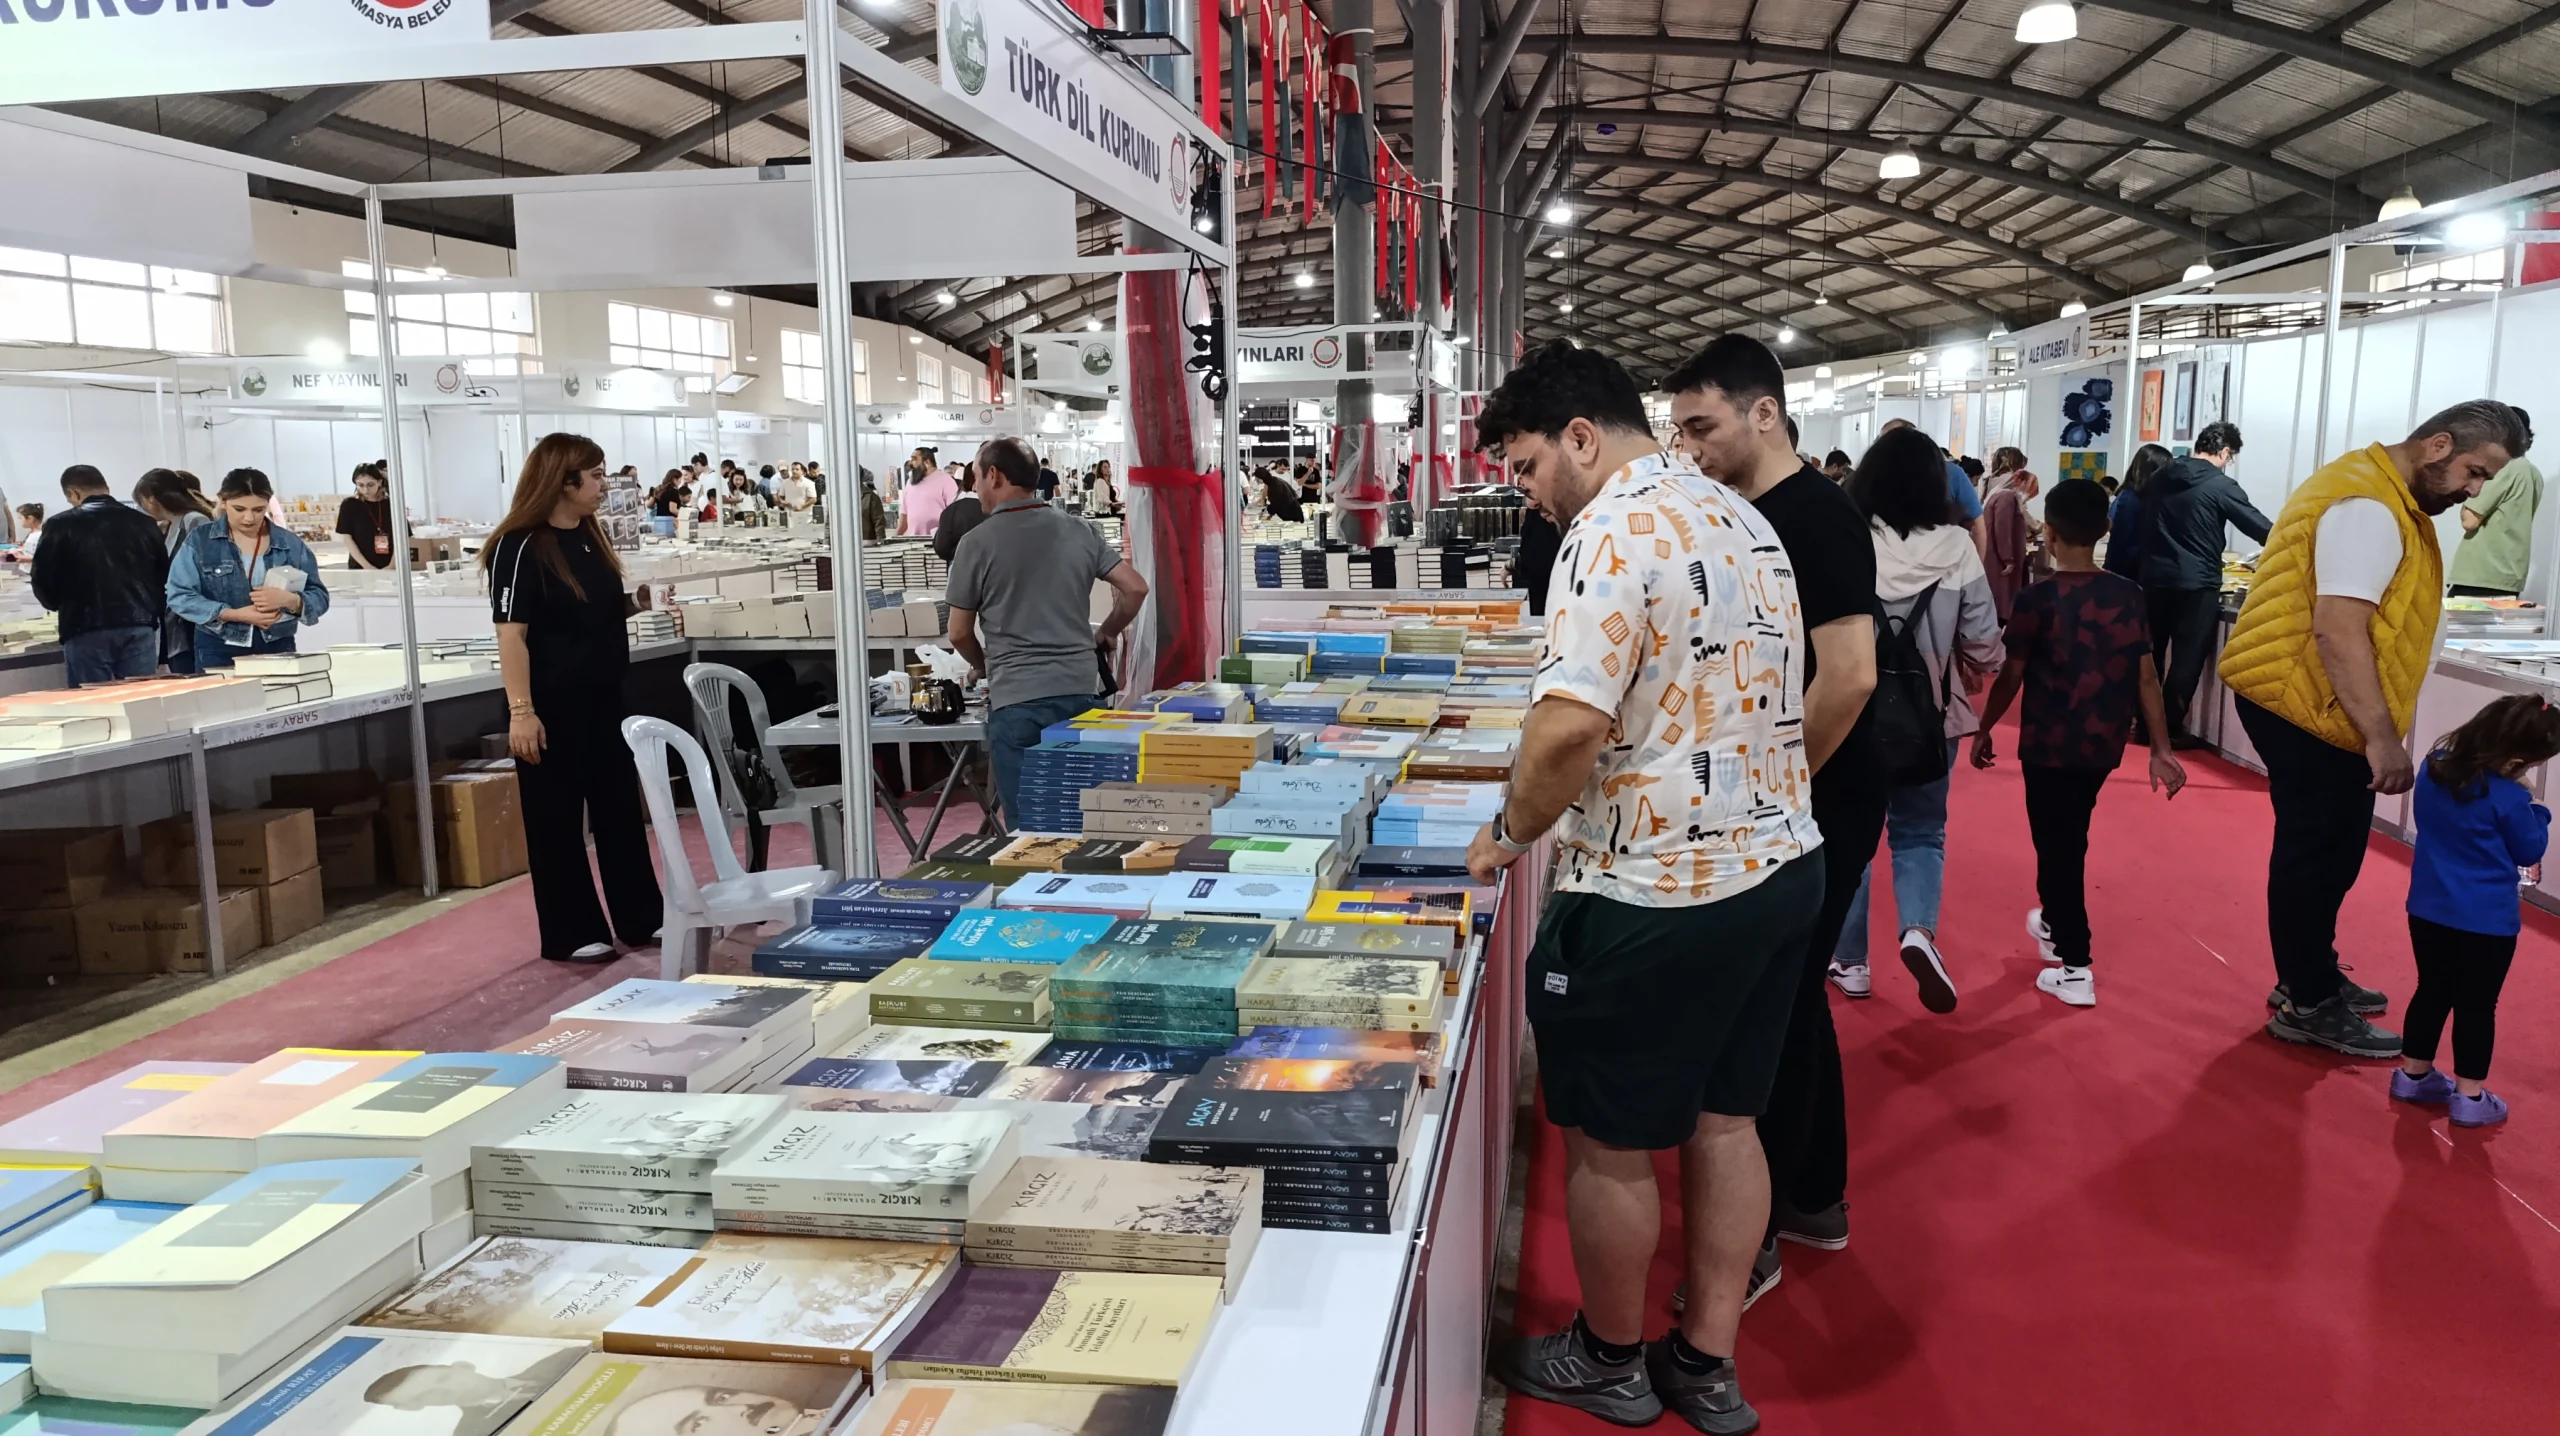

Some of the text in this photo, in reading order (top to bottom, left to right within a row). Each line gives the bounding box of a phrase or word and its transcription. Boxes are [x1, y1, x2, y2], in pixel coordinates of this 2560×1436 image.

[1004, 36, 1160, 184] TÜRK DİL KURUMU
[293, 374, 408, 389] NEF YAYINLRI
[595, 378, 612, 391] NEF
[393, 692, 413, 704] RAY
[281, 710, 318, 728] SARAY
[192, 951, 206, 960] ADE
[592, 987, 651, 1012] KAZAK
[517, 1029, 586, 1055] KIRGIZ
[567, 1076, 647, 1089] KIRGIZ DESTANLAR
[1008, 1076, 1039, 1100] AZAK
[520, 1101, 590, 1137] KIRGIZ
[757, 1124, 818, 1162] KIRGIZ
[629, 1166, 671, 1178] KIRGIZ
[1011, 1171, 1057, 1208] KIRGIZ
[879, 1193, 921, 1205] KIRGIZ
[627, 1203, 667, 1216] KIRGIZ
[988, 1226, 1016, 1235] KIRGIZ
[986, 1238, 1014, 1247] KIRGIZ
[986, 1252, 1014, 1261] KIRGIZ
[1073, 1297, 1113, 1353] Osmanlı Türkçesi
[1088, 1298, 1128, 1354] Telaffuz Kayıtları
[923, 1365, 1047, 1380] Osmanlı Türkçesi Telaffuz Kayıtları
[261, 1387, 291, 1408] Samih
